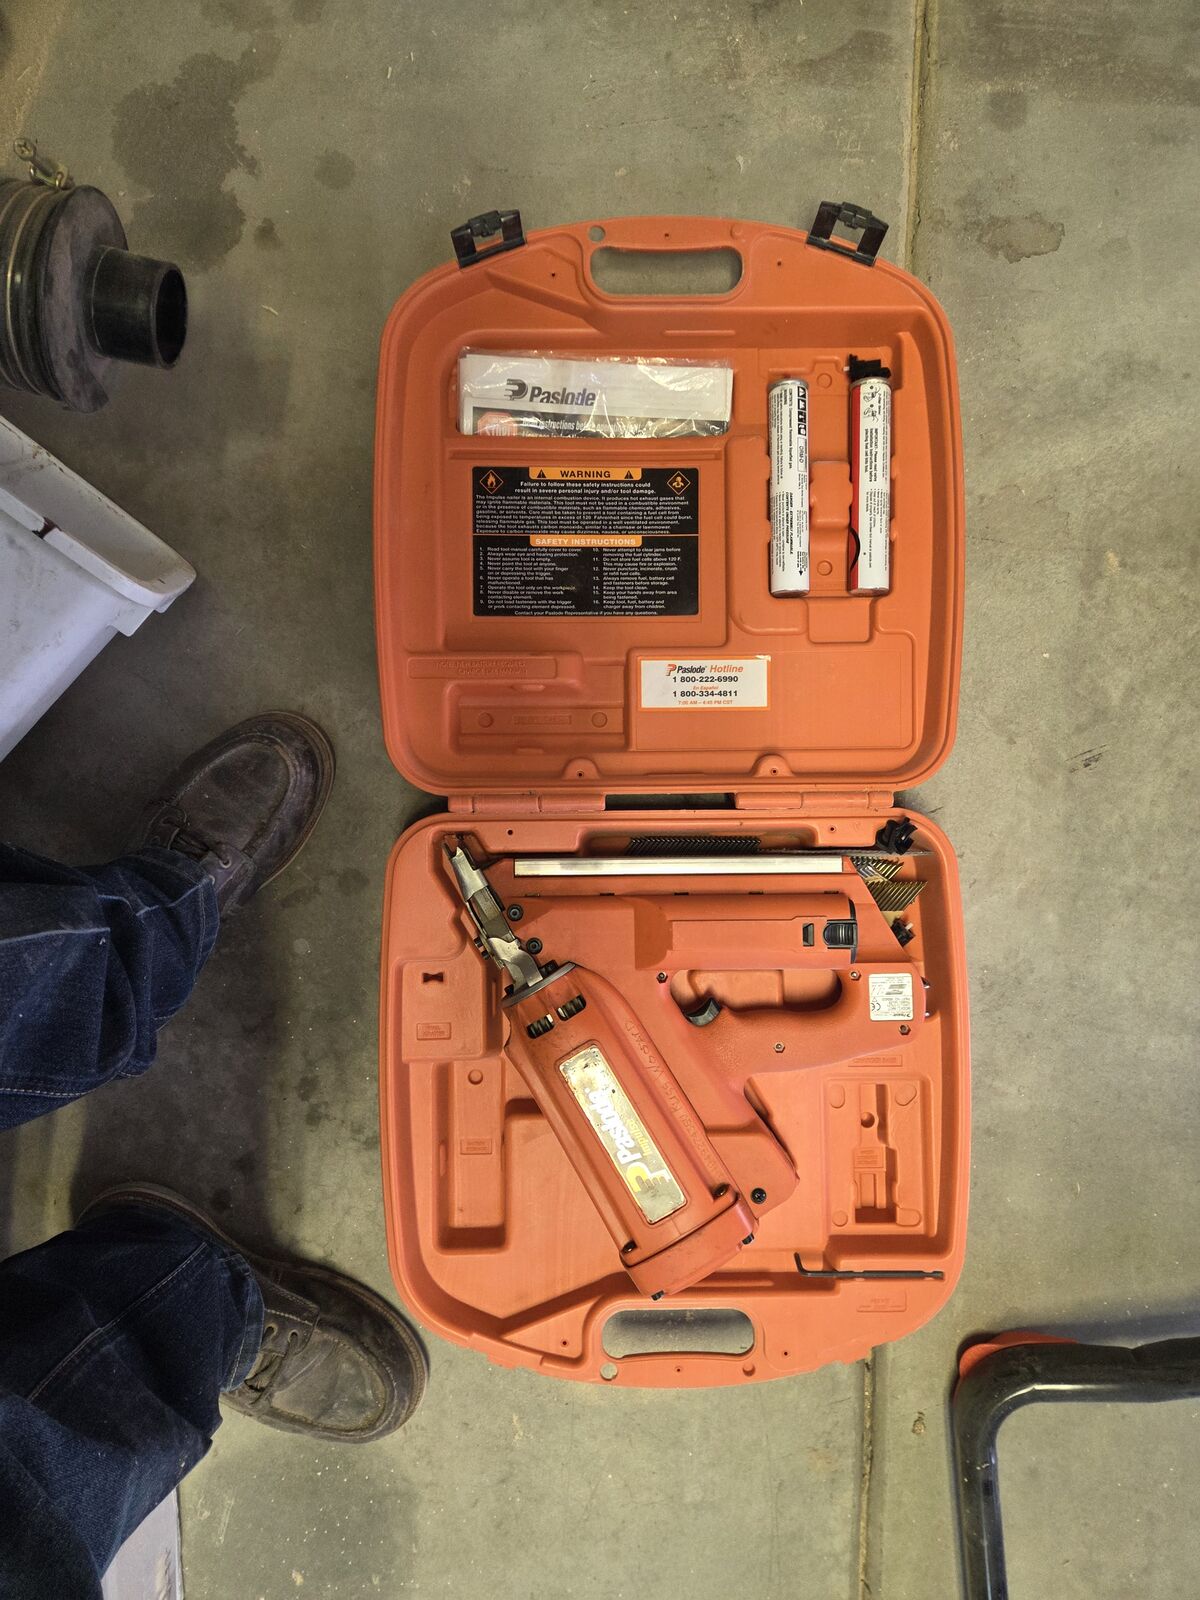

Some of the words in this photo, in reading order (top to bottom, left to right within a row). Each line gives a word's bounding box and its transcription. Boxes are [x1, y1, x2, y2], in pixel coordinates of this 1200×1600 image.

[529, 386, 596, 406] Paslode
[677, 665, 705, 674] Paslode
[710, 664, 743, 673] Hotline
[588, 1090, 643, 1165] Paslode
